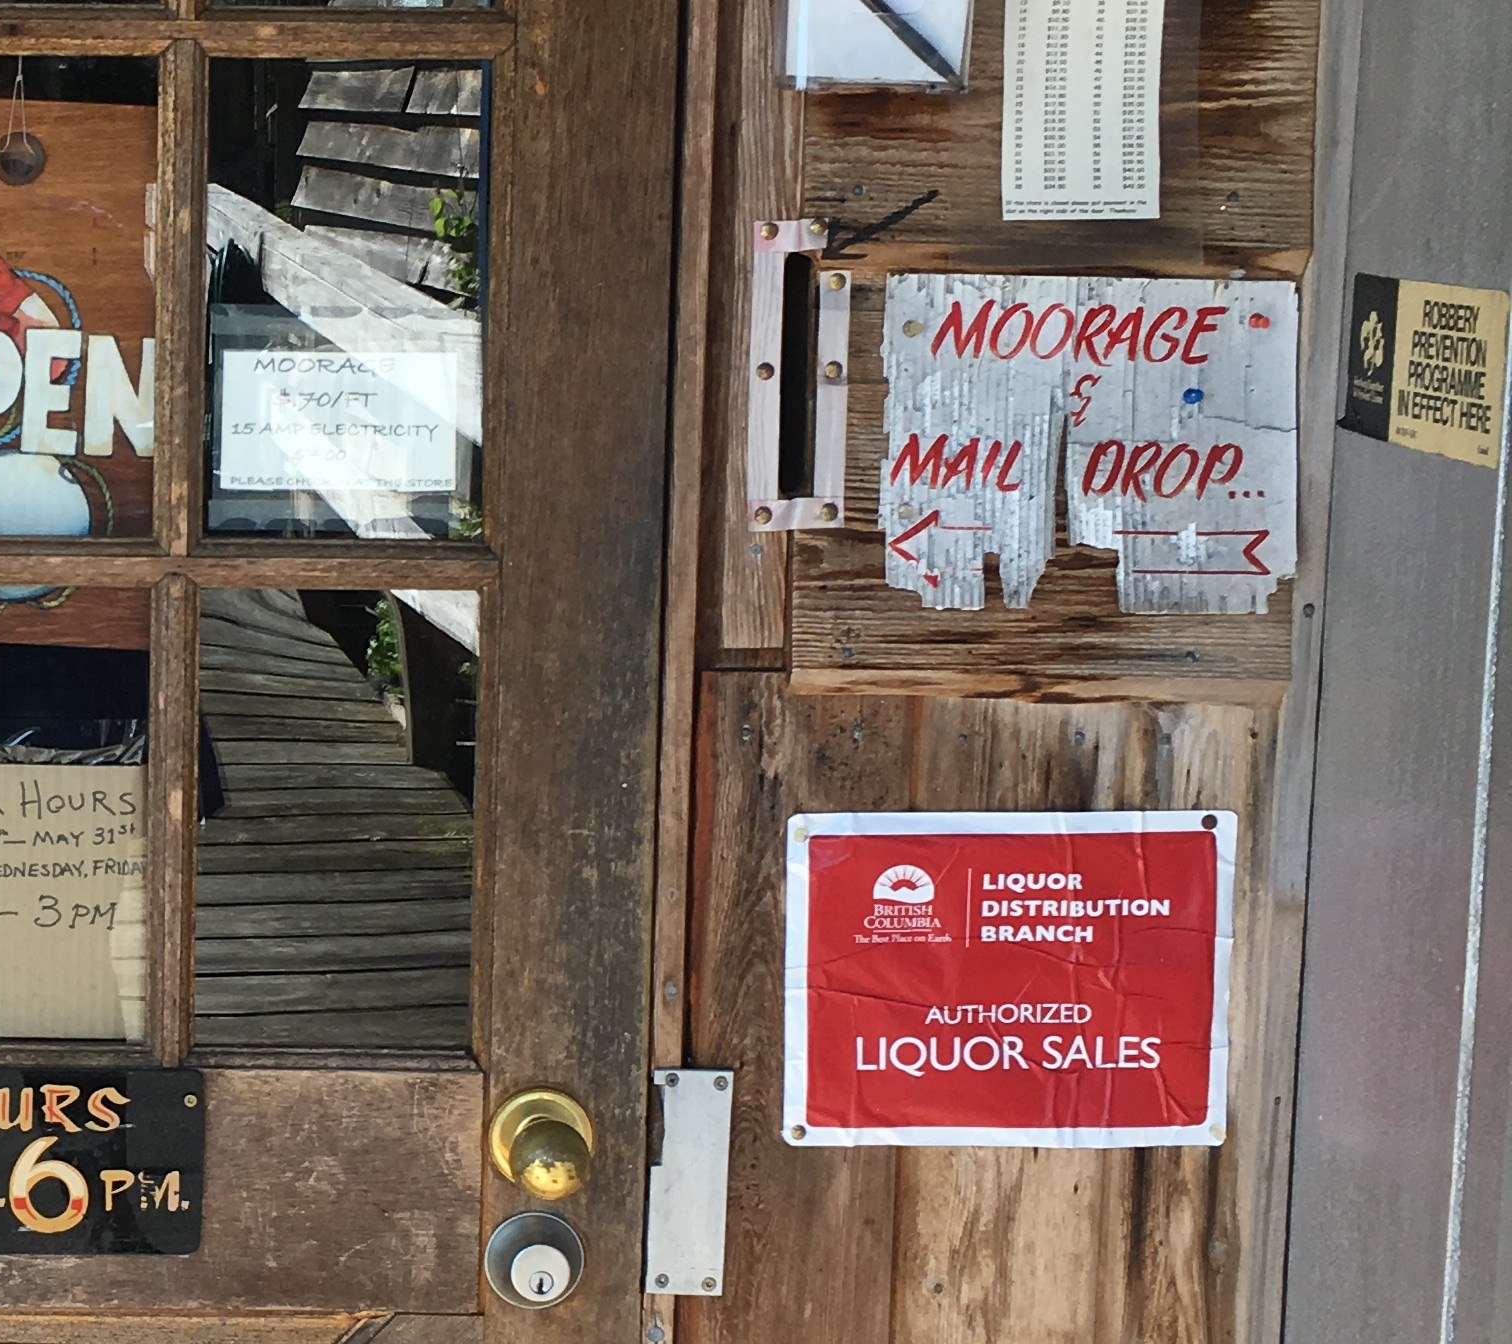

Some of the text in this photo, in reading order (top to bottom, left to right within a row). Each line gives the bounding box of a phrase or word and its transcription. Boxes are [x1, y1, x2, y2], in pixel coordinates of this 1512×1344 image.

[1422, 299, 1481, 335] ROBBERY
[930, 298, 1229, 367] MOORAGE
[1411, 330, 1487, 368] PREVENTION
[1407, 360, 1487, 401] PROGRAMME
[1397, 389, 1410, 417] IN
[1412, 392, 1458, 428] EFFECT
[1458, 398, 1492, 435] HERE
[231, 422, 256, 436] 15
[310, 423, 439, 443] ELECTRICITY
[889, 432, 1267, 504] MAIL DROP...
[230, 476, 284, 487] PLEASE
[405, 478, 453, 489] STORE
[19, 779, 138, 820] HOURS
[32, 830, 85, 848] MAY
[92, 822, 137, 846] 31st
[982, 872, 1083, 893] LIQUOR
[873, 904, 933, 916] BRITISH
[981, 898, 1171, 918] DISTRIBUTION
[863, 915, 942, 929] COLUMBIA
[980, 924, 1094, 944] BRANCH
[853, 934, 870, 943] The
[871, 934, 889, 943] Best
[891, 932, 913, 943] Place
[927, 933, 952, 943] Earth
[925, 1003, 1092, 1025] AUTHORIZED
[855, 1035, 1162, 1077] LIQUOR SALES
